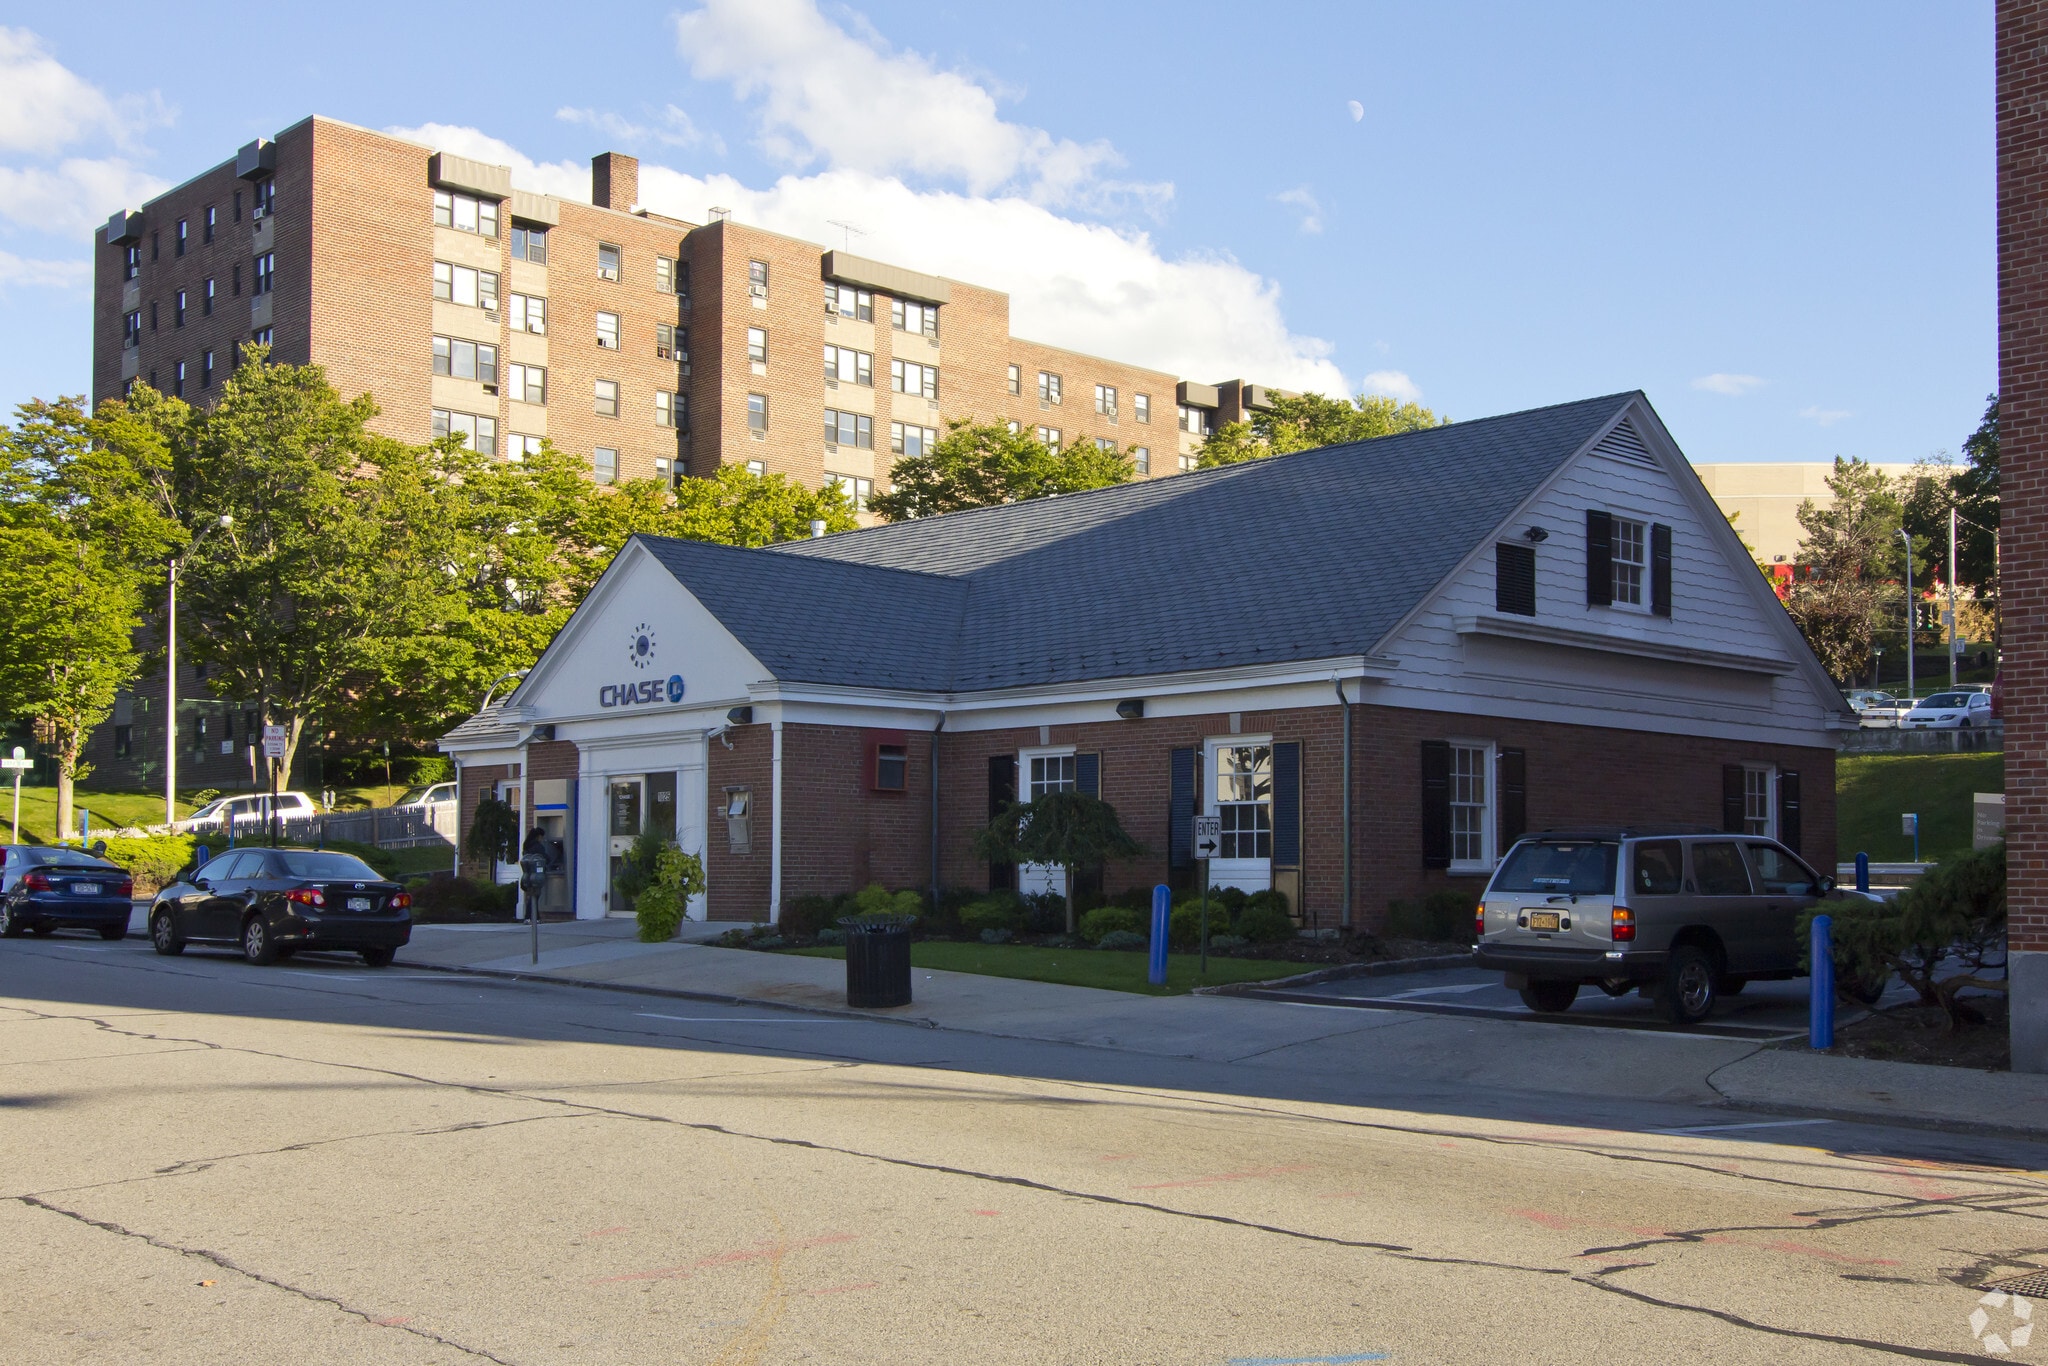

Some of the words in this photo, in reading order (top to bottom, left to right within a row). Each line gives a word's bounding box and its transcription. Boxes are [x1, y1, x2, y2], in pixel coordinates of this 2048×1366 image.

[600, 679, 664, 707] CHASE
[1198, 821, 1218, 835] ENTER
[1977, 819, 2000, 828] Parking
